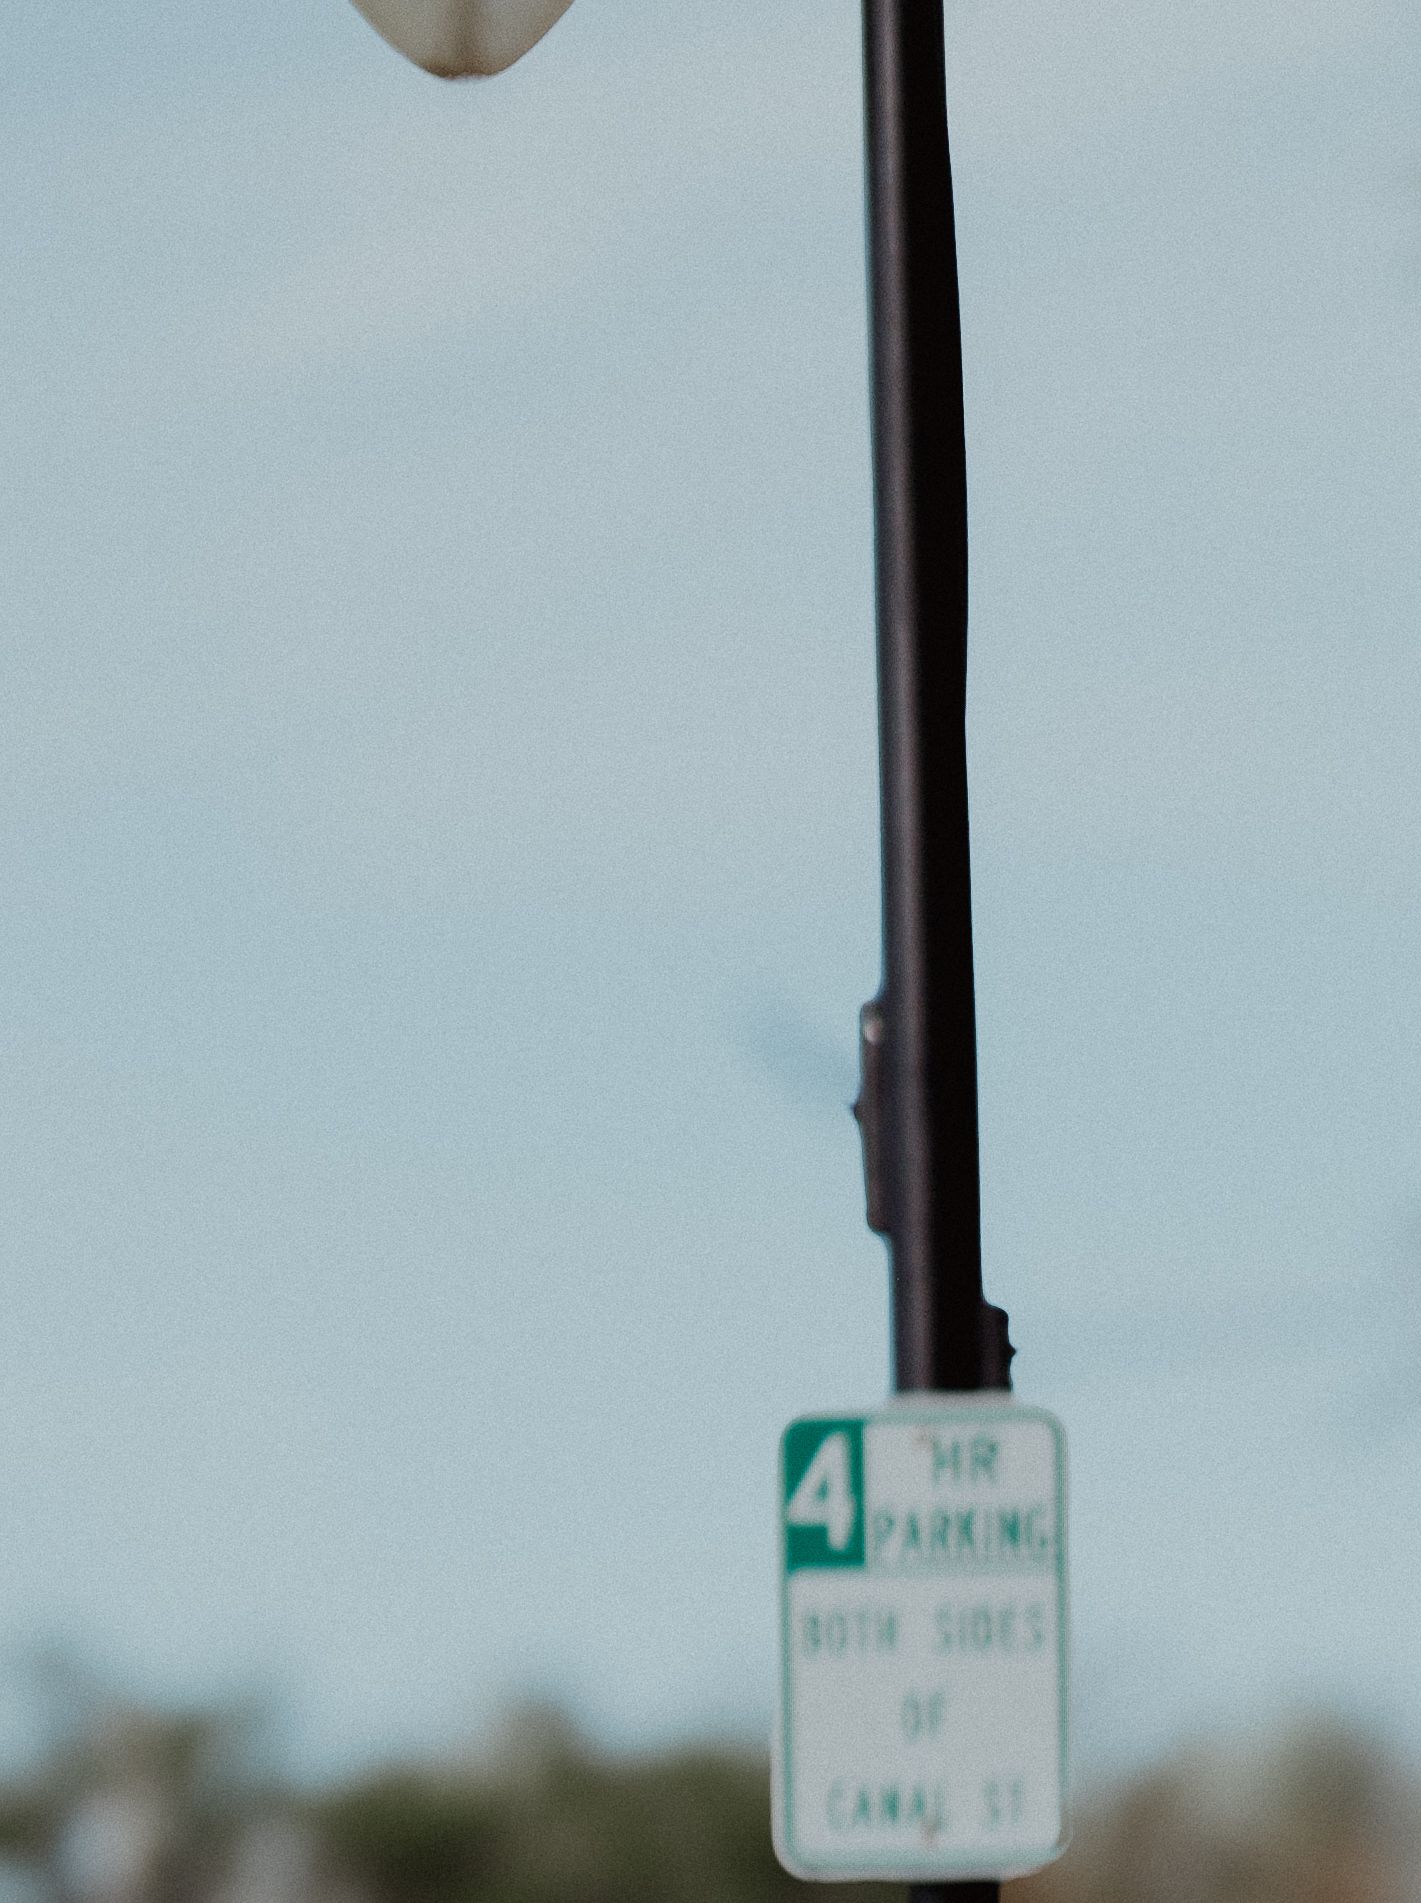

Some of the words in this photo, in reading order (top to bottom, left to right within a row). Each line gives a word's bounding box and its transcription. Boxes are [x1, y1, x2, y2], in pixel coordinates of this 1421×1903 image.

[931, 1436, 1000, 1488] HR
[787, 1429, 856, 1552] 4
[873, 1509, 1051, 1556] PARKING
[804, 1607, 900, 1656] BOTH
[932, 1604, 1046, 1655] SIDES
[900, 1690, 948, 1741] OF
[827, 1781, 948, 1832] CANAL
